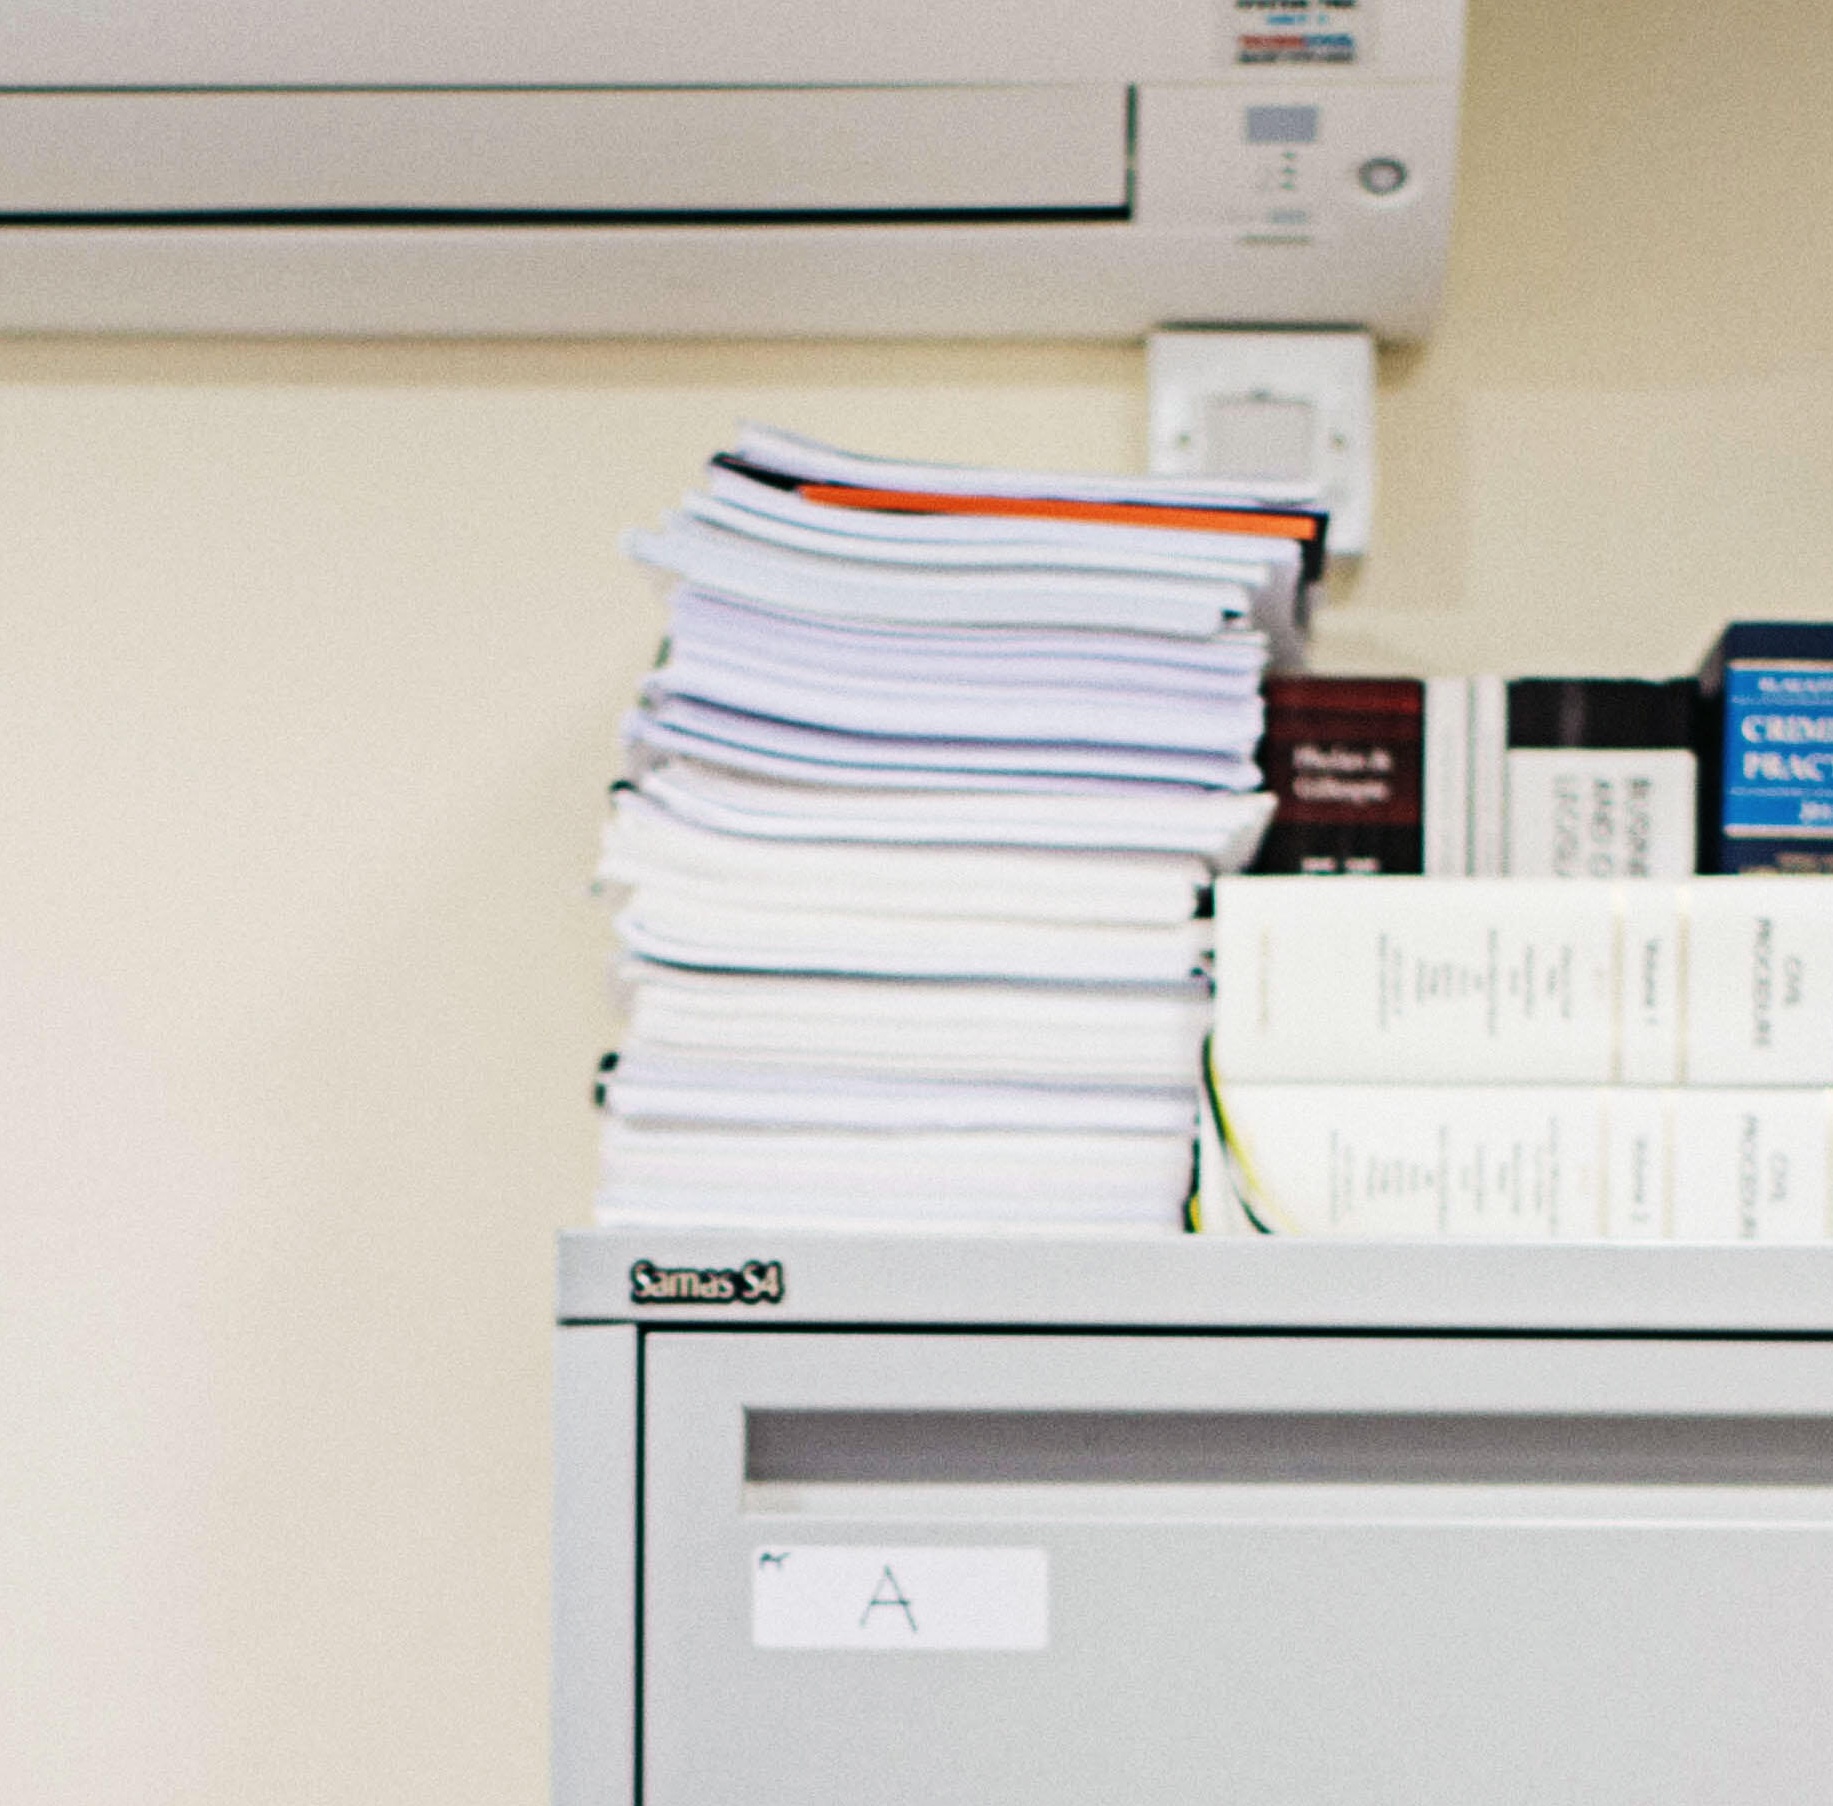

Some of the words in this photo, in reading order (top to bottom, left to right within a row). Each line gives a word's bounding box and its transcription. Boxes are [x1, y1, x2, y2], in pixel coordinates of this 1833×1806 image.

[1624, 778, 1654, 877] BUSINE
[1751, 918, 1773, 1047] PROCEDURE
[633, 1262, 736, 1298] Samas
[741, 1262, 781, 1298] S4
[858, 1563, 919, 1633] A
